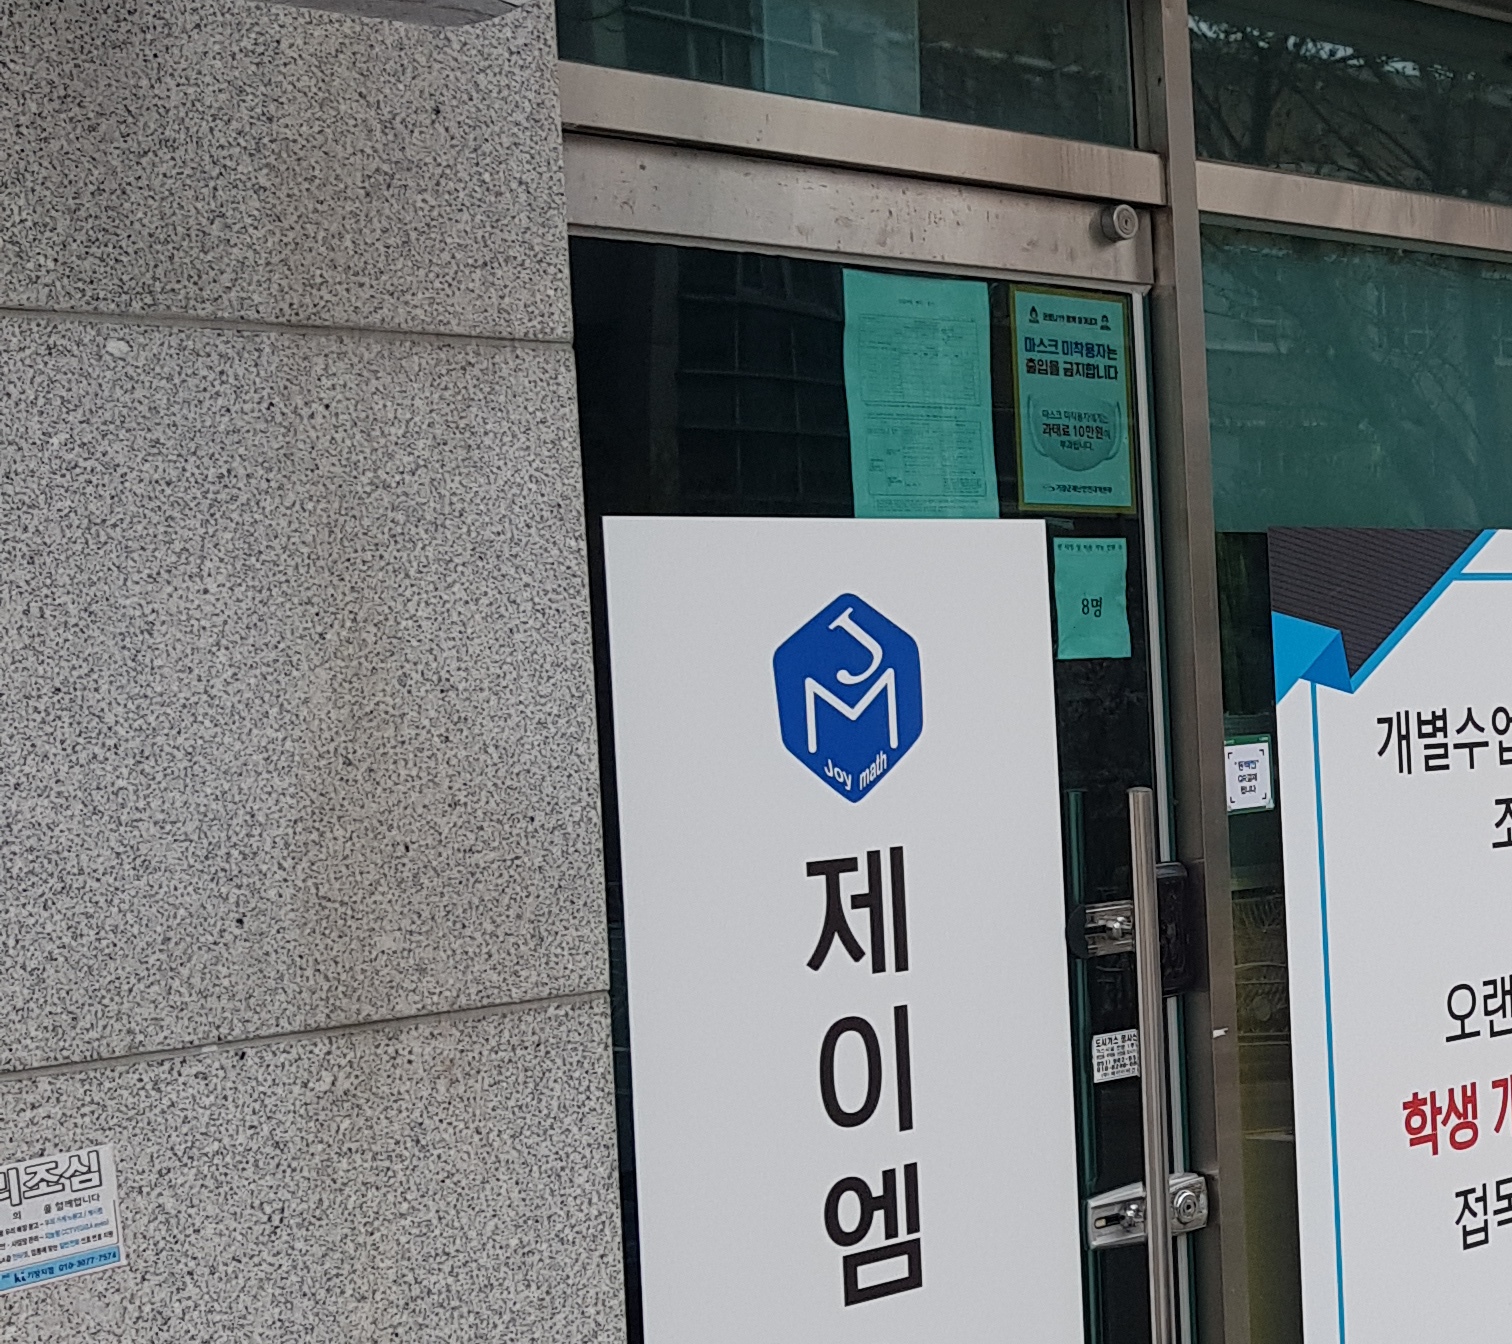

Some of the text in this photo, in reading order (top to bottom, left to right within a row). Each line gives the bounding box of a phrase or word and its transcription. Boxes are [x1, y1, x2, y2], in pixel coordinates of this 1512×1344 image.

[1024, 336, 1118, 361] 마스크 미착용자는
[1025, 357, 1119, 381] 출입을 금지합니다
[1042, 422, 1071, 437] 과태료
[1081, 596, 1102, 618] 8명
[823, 750, 888, 791] Joy math
[1401, 1079, 1479, 1157] 학생
